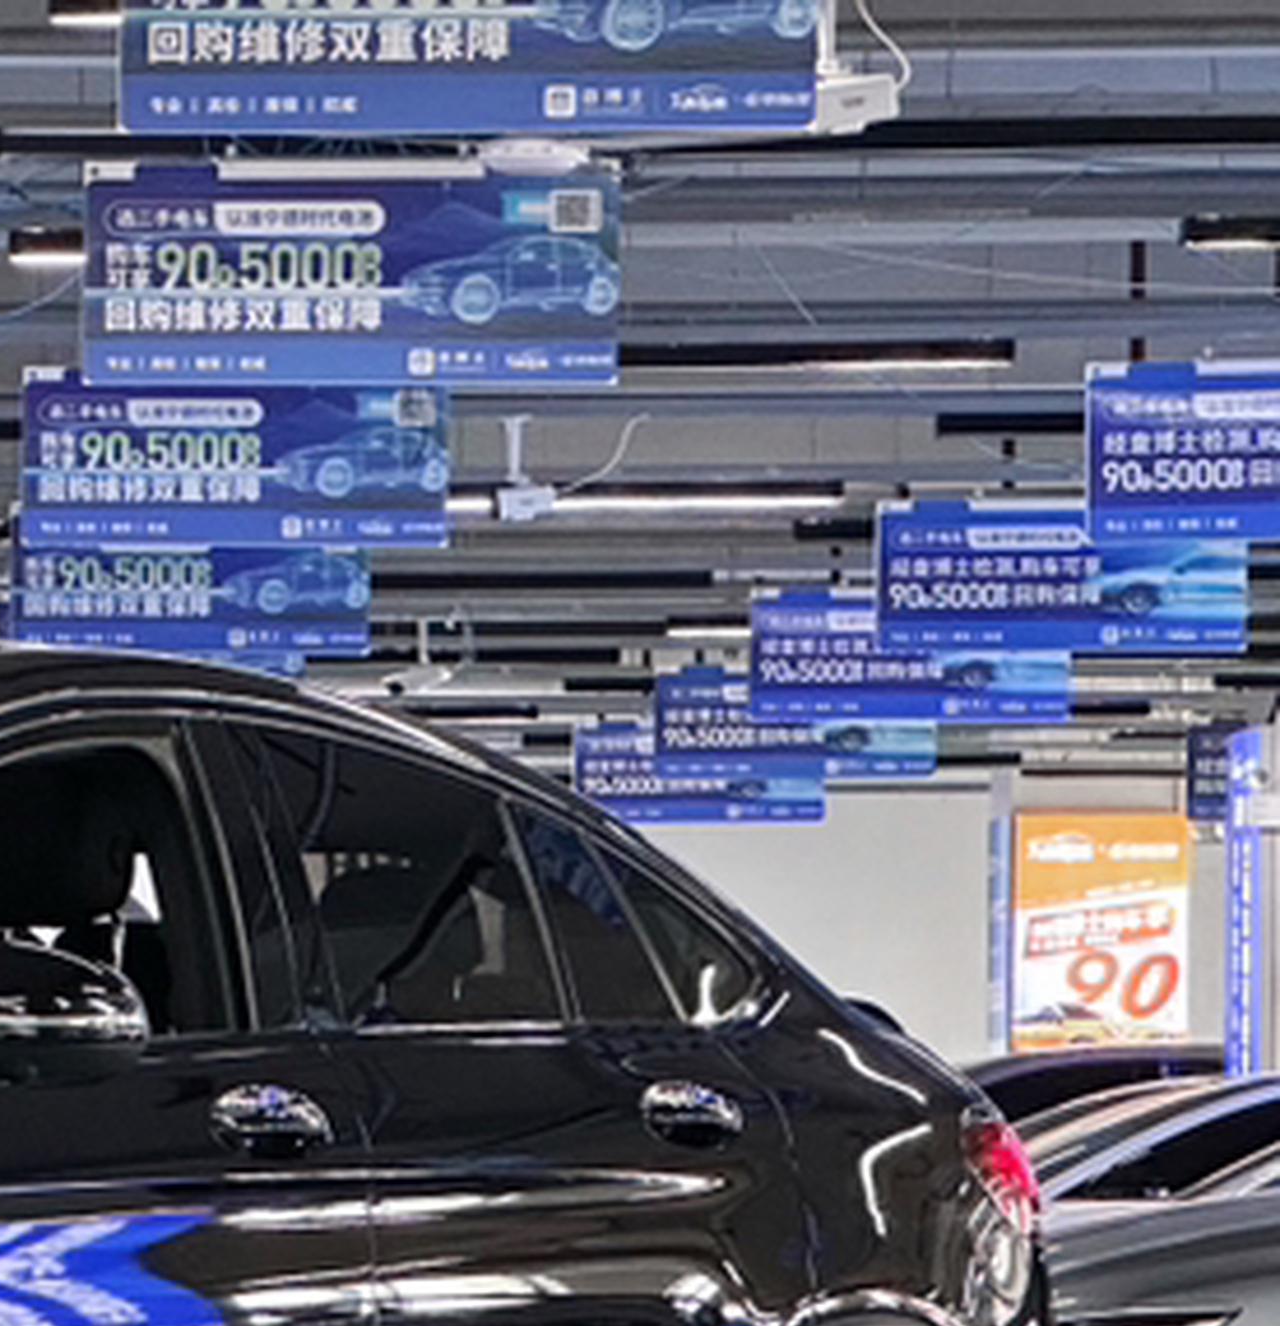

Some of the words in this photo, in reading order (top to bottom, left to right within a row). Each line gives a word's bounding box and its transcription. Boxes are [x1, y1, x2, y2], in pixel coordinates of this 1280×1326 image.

[148, 19, 510, 64] 回购维修双重保障
[104, 297, 382, 332] 回购维修双重保障
[1066, 951, 1179, 1018] 90
